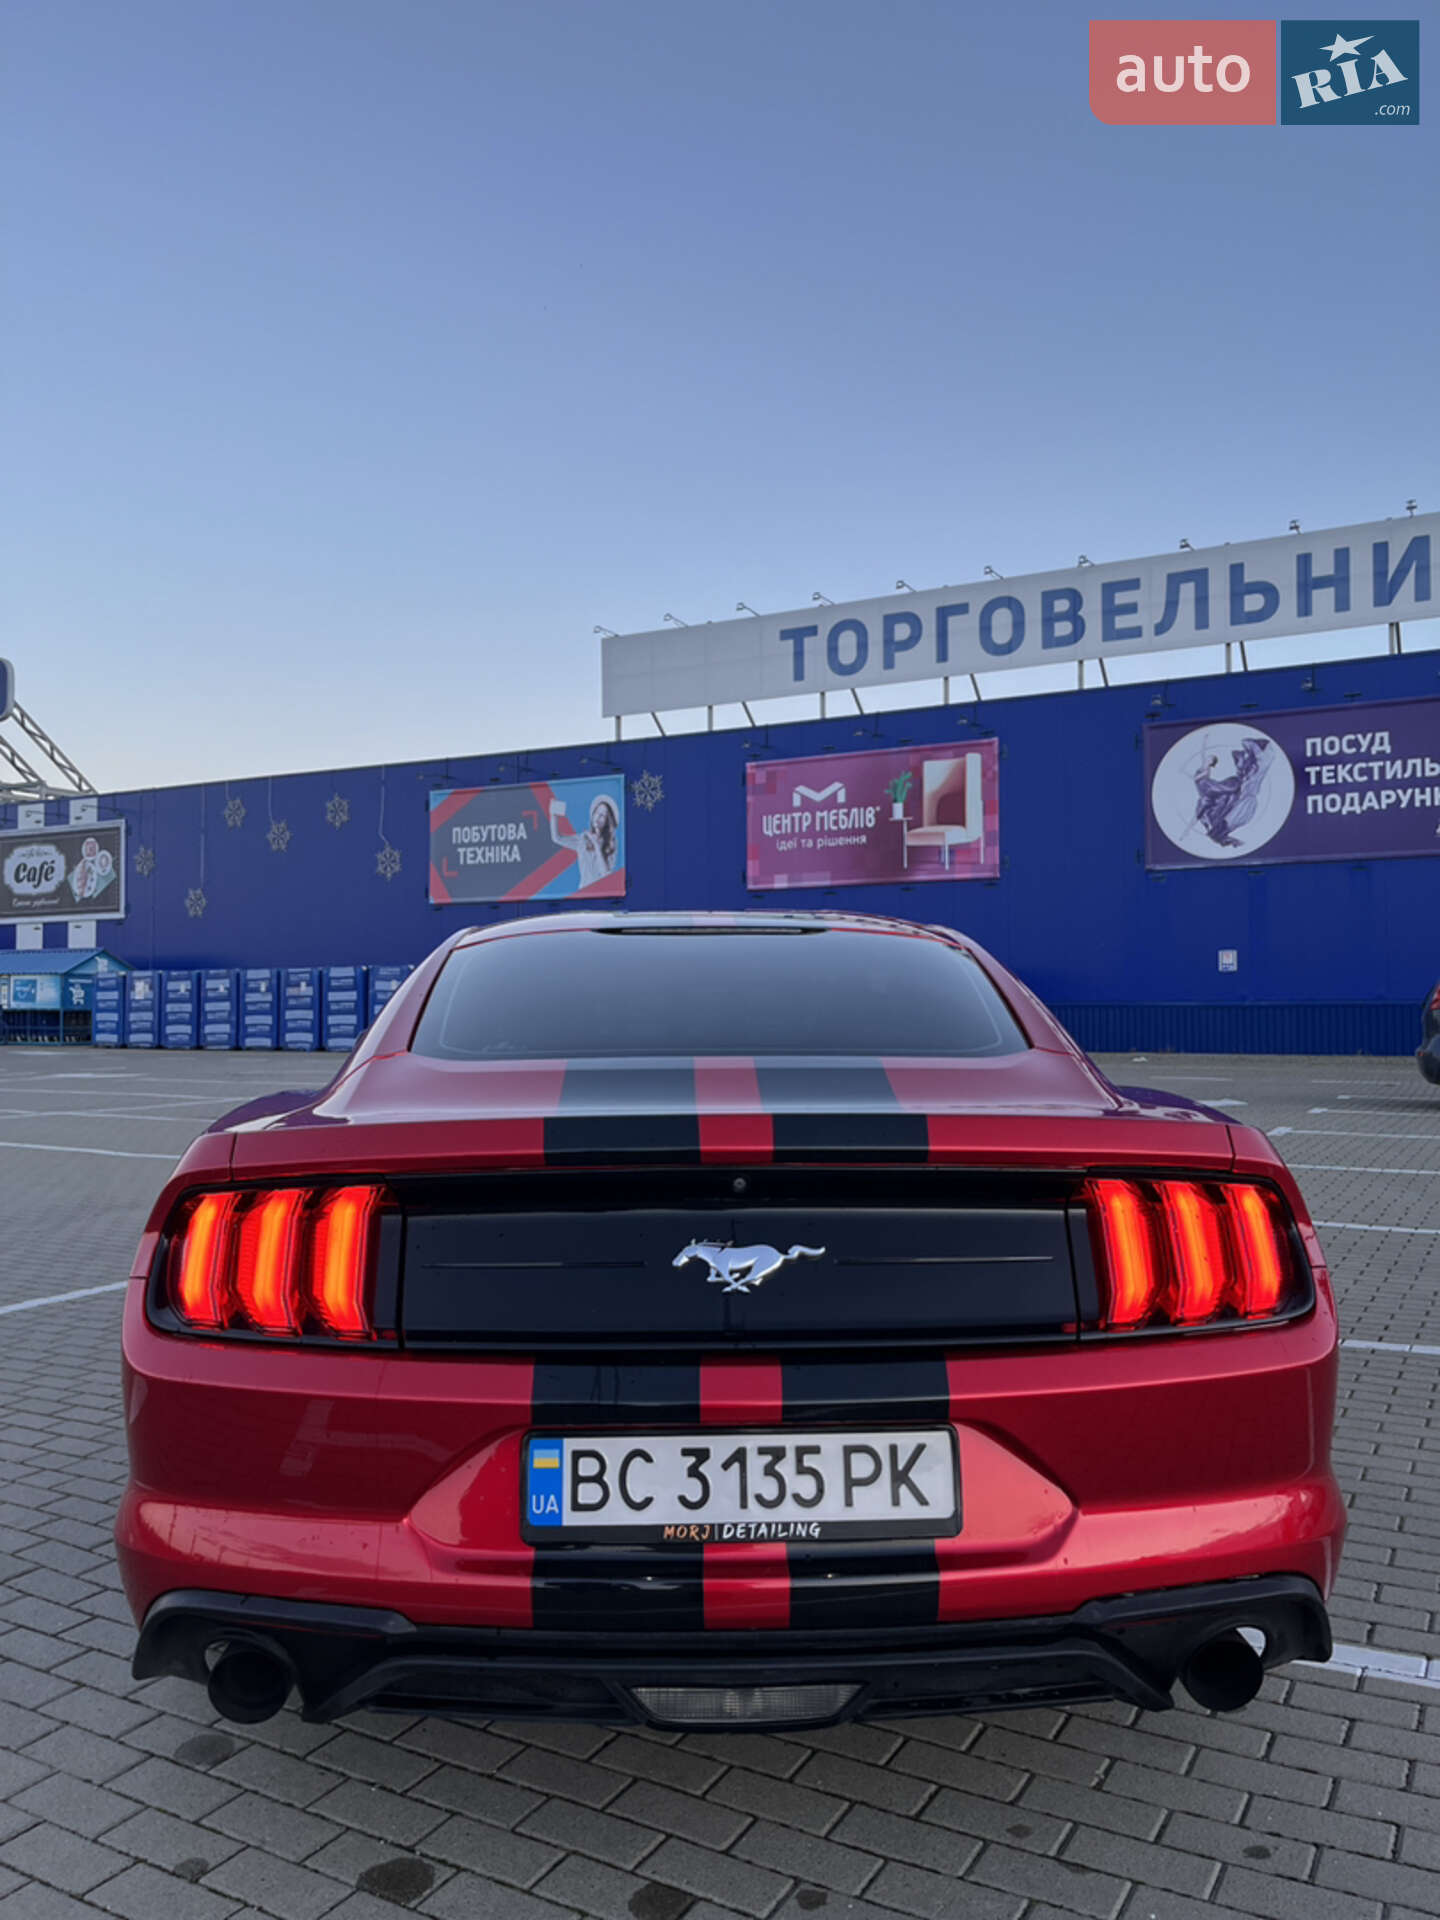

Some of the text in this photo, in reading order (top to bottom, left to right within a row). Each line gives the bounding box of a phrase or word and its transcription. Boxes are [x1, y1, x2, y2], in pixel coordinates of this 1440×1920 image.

[779, 534, 1432, 683] ТОРГОВЕЛЬНИ
[1306, 731, 1392, 758] ПОСУД
[1304, 757, 1440, 786] ТЕКСТИЛЬ
[452, 822, 527, 845] ПОБУТОВА
[762, 811, 812, 837] ЦЕНТР
[457, 844, 521, 865] ТЕХНІКА
[800, 838, 814, 849] та
[817, 834, 868, 850] рішення
[14, 860, 56, 889] Café
[570, 1443, 931, 1512] BC 3135 PK
[531, 1494, 560, 1515] UA
[722, 1521, 821, 1540] DETAILING
